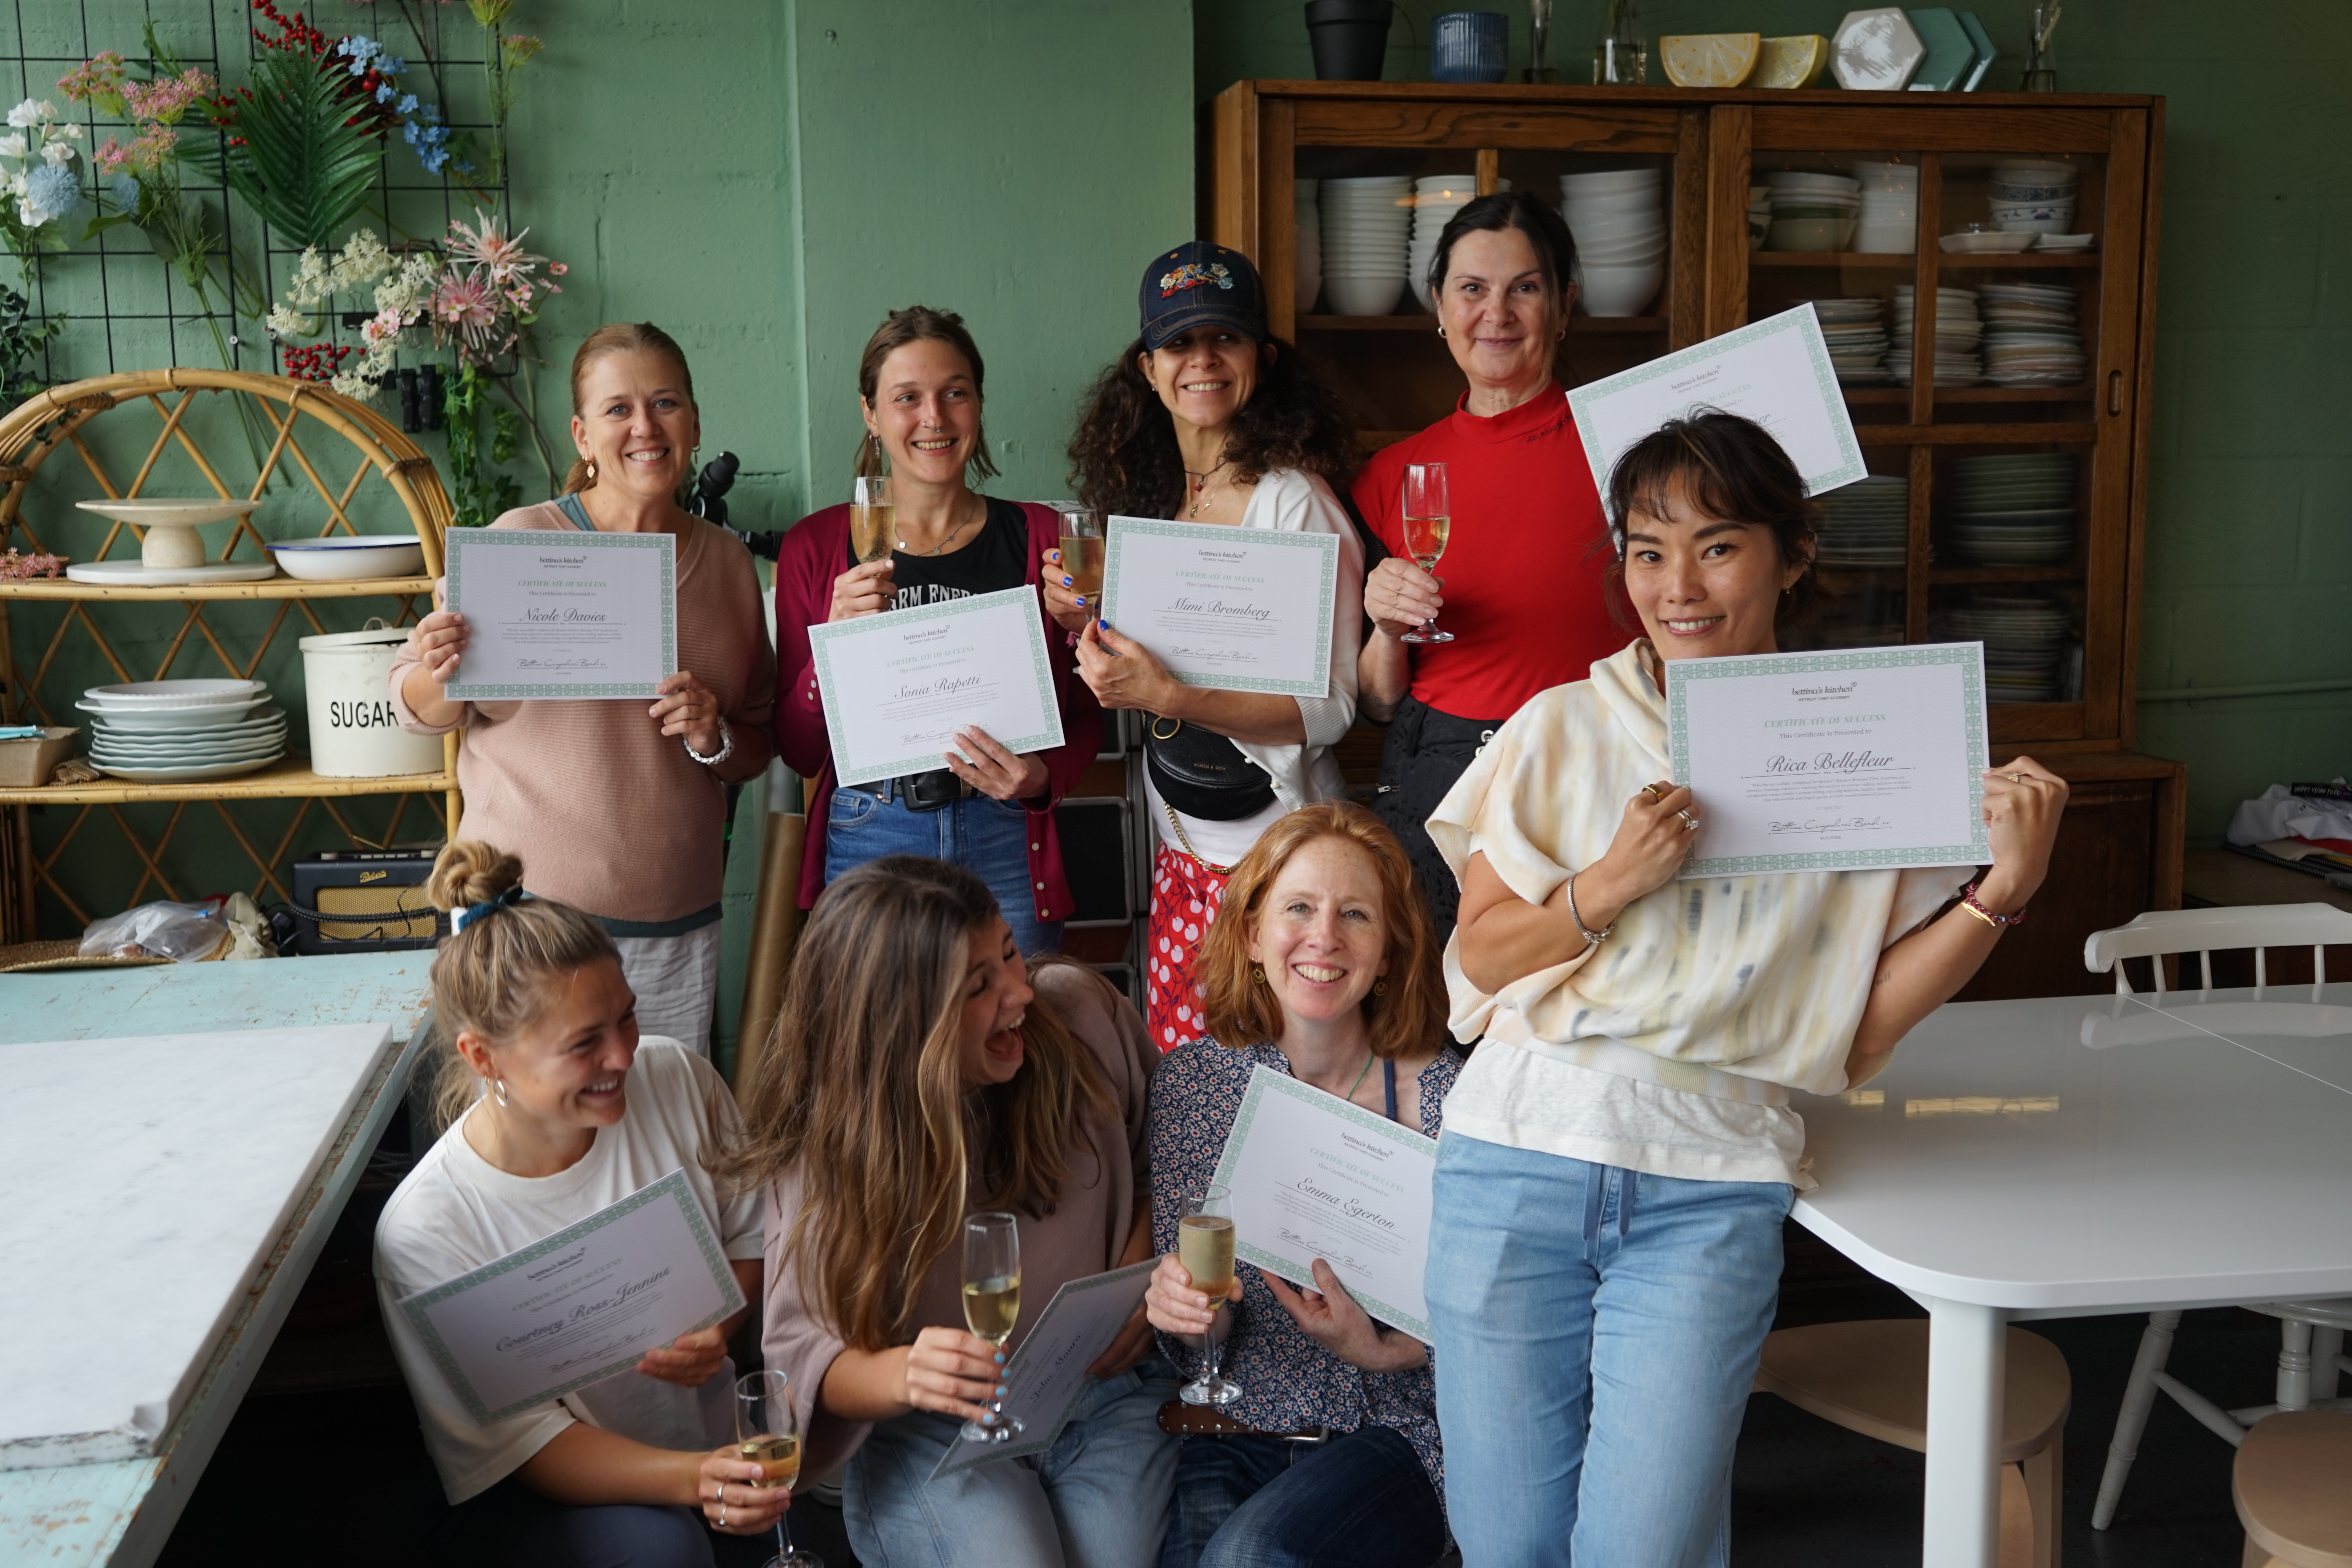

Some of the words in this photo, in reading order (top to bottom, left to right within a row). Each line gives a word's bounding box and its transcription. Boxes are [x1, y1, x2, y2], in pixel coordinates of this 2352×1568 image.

[1671, 377, 1696, 390] bettina's
[1697, 369, 1719, 380] kitchen
[1718, 383, 1751, 399] SUCCESS
[1176, 571, 1221, 579] CERTIFICATE
[519, 608, 560, 621] Nicole
[564, 608, 605, 621] Davies
[1168, 597, 1204, 611] Mimi
[1207, 600, 1270, 621] Bromberg
[904, 632, 926, 640] bettina's
[887, 653, 931, 667] CERTIFICATE
[944, 646, 974, 656] SUCCESS
[895, 685, 929, 699] Sonia
[935, 674, 980, 694] Rapetti
[1792, 686, 1823, 695] bettina's
[1764, 717, 1826, 728] CERTIFICATE
[1844, 714, 1886, 723] SUCCESS
[1766, 755, 1808, 773] Rica
[1814, 750, 1895, 774] Bellefleur
[2327, 788, 2340, 796] FOOD
[1341, 1132, 1366, 1147] bettina's
[1367, 1143, 1389, 1158] kitchen
[1344, 1142, 1359, 1151] RETREAT
[1368, 1153, 1384, 1162] ACADEMY
[1310, 1147, 1359, 1172] CERTIFICATE
[1371, 1174, 1405, 1193] SUCCESS
[1329, 1168, 1354, 1181] Certificate
[1359, 1181, 1383, 1195] Presented
[1297, 1178, 1340, 1205] Emma
[1344, 1198, 1395, 1229] Egerton
